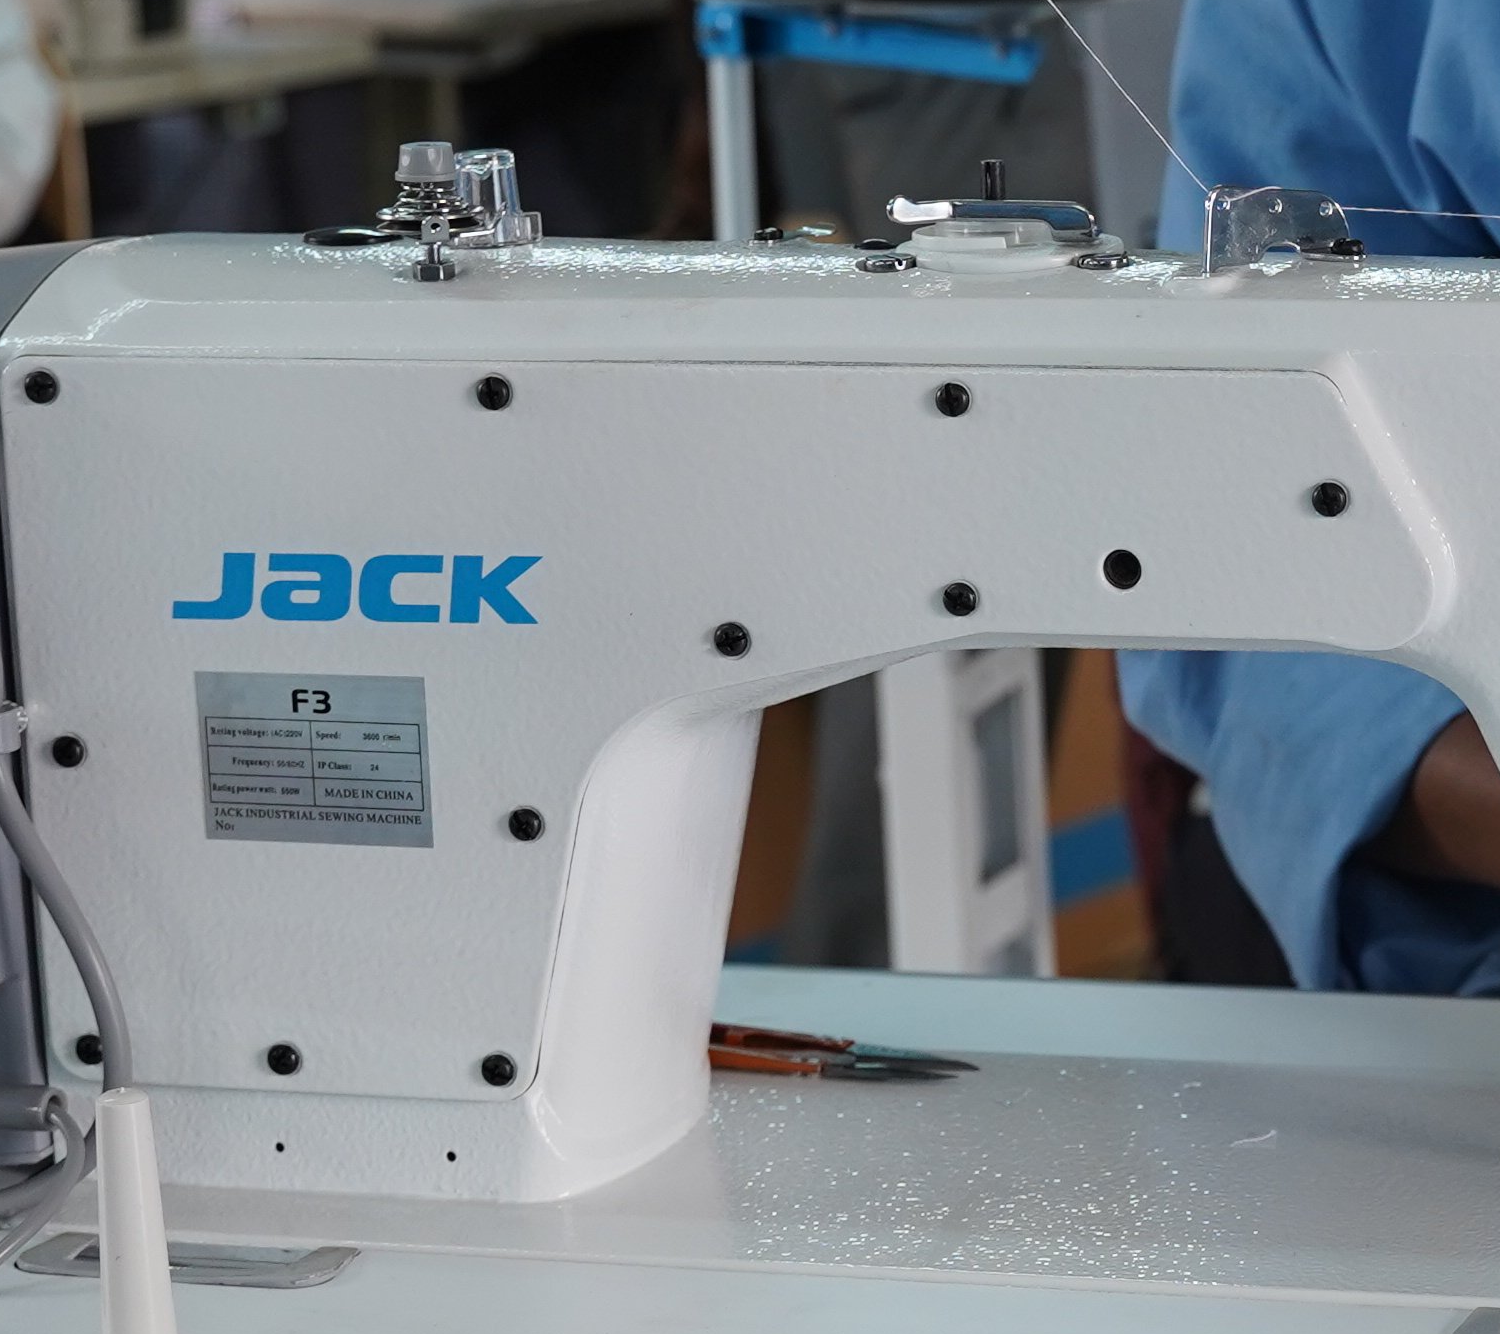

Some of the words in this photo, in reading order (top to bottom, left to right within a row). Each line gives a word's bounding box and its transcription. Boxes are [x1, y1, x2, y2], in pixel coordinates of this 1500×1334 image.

[291, 688, 331, 714] F3
[316, 731, 341, 741] Speed:
[317, 762, 327, 770] IP
[324, 788, 359, 799] MADE
[362, 789, 374, 799] IN
[376, 790, 413, 801] CHINA
[214, 808, 243, 818] JACK
[245, 809, 316, 821] INDUSTRIAL
[318, 812, 364, 823] SEWING
[366, 813, 422, 825] MACHINE
